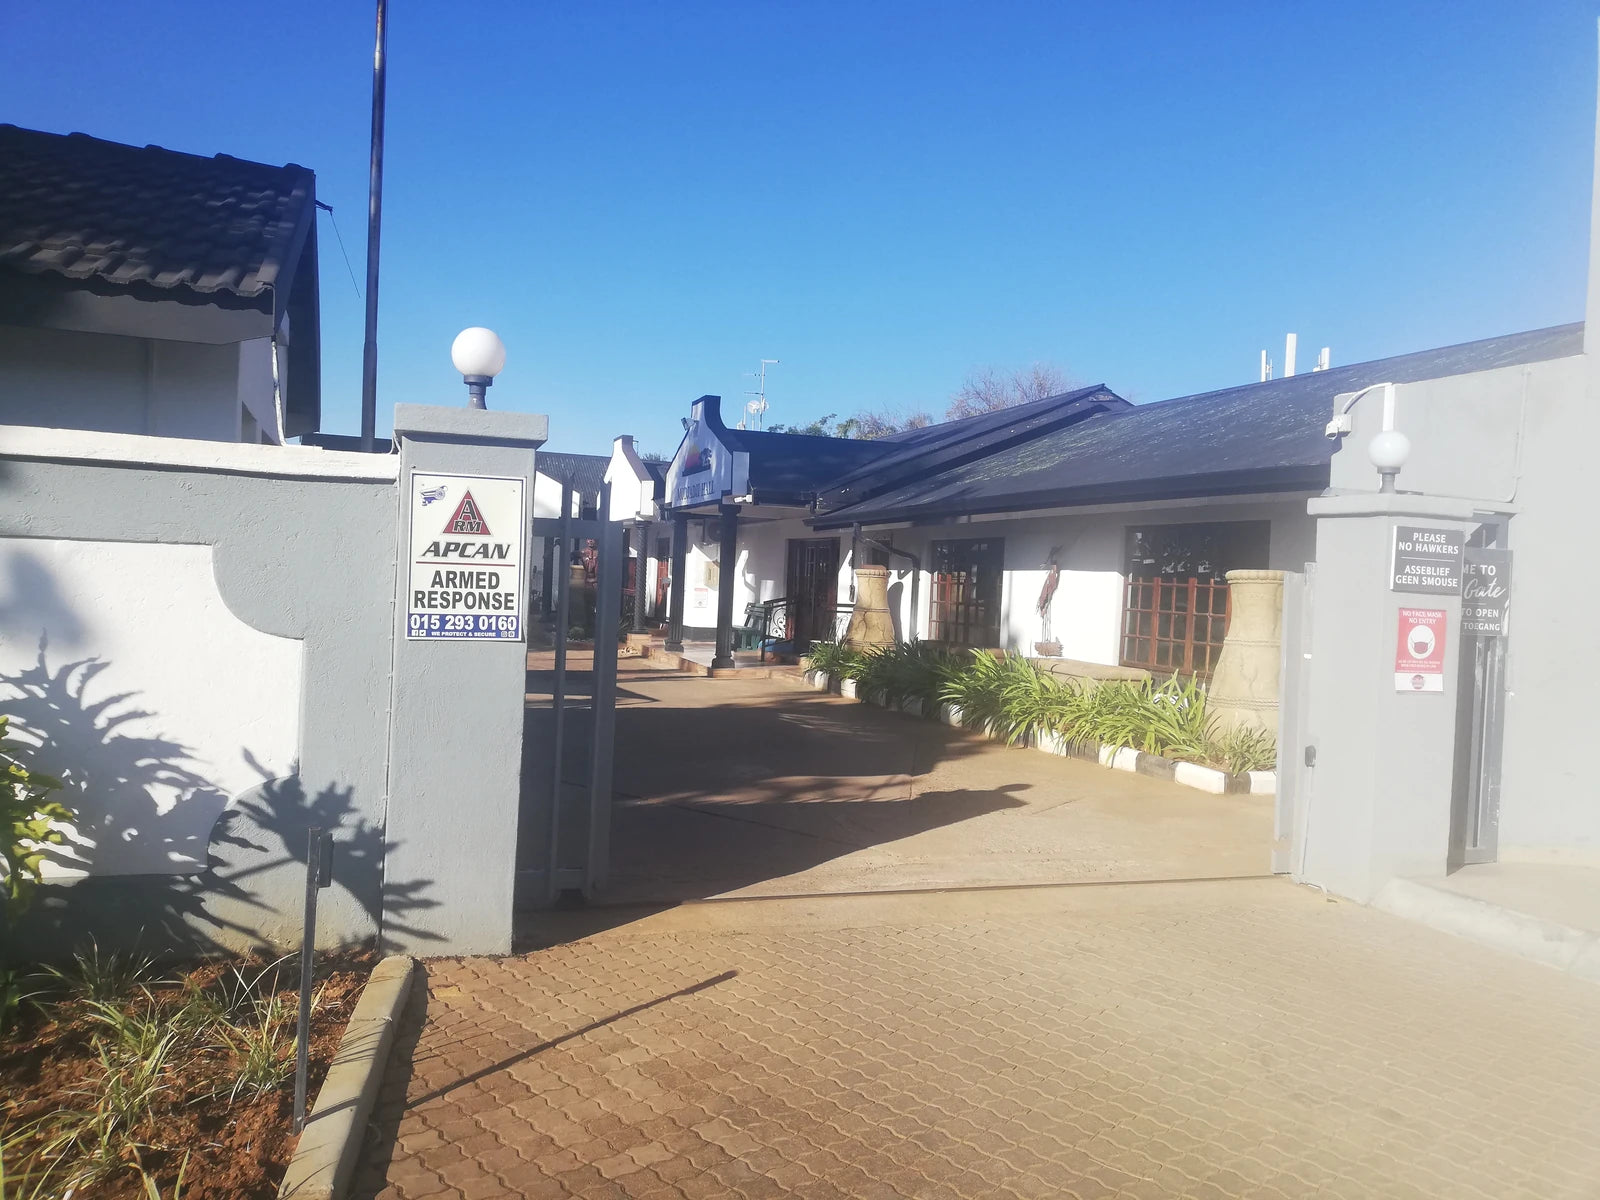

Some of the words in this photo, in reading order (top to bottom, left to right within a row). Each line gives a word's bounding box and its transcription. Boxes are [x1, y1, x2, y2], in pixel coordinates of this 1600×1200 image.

[1413, 532, 1447, 543] PLEASE
[421, 541, 513, 560] APCAN
[1398, 541, 1412, 551] NO
[1415, 543, 1459, 554] HAWKERS
[1404, 565, 1450, 576] ASSEBLIEF
[1479, 564, 1497, 576] TO
[430, 570, 500, 590] ARMED
[1395, 574, 1419, 585] GEEN
[1421, 576, 1458, 587] SMOUSE
[1464, 577, 1506, 599] Gate
[413, 590, 515, 611] RESPONSE
[1475, 608, 1499, 618] OPEN
[410, 614, 440, 630] 015
[444, 615, 474, 631] 293
[478, 615, 517, 631] 0160
[1418, 617, 1437, 625] ENTRY
[1463, 622, 1500, 631] TOEGANG
